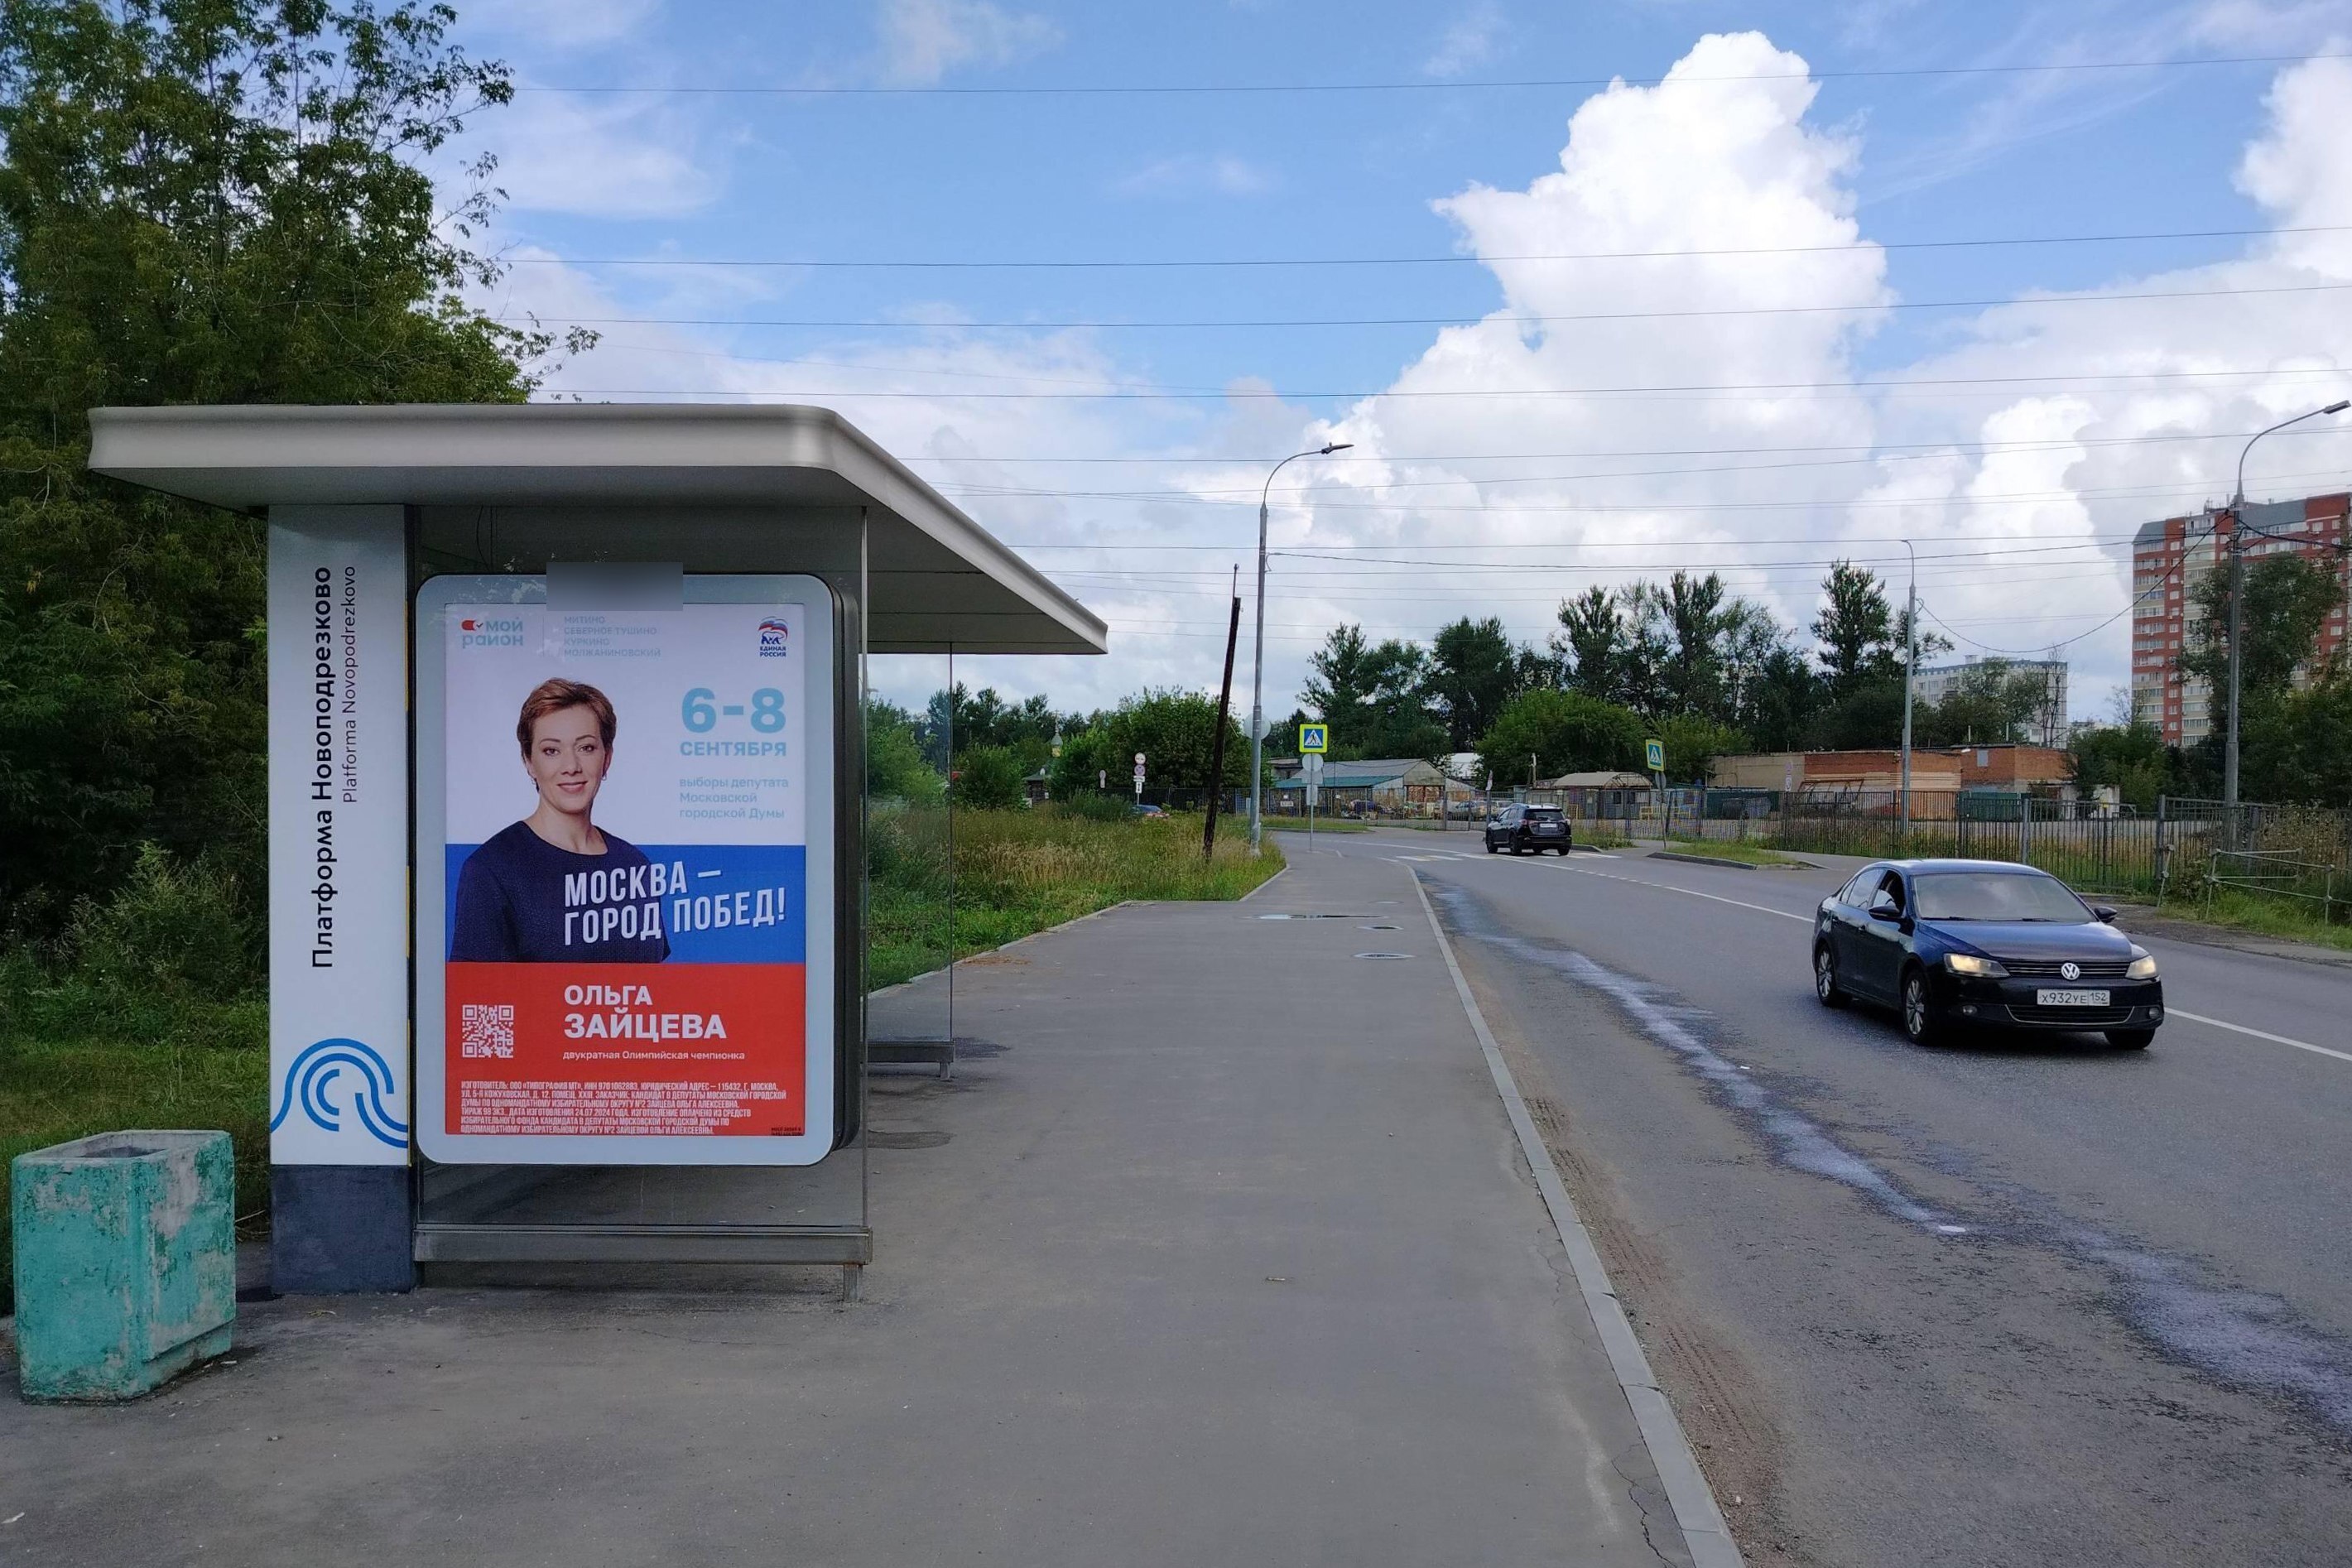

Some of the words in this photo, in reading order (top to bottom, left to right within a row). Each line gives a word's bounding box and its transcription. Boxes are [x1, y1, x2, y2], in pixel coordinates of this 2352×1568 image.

[564, 615, 606, 623] МИТИНО
[564, 627, 613, 635] СЕВЕРНОЕ
[614, 627, 657, 635] ТУШИНО
[340, 566, 358, 713] Novopodrezkovo
[564, 637, 610, 646] КУРКИНО
[564, 647, 661, 657] МОЛЖАНИНОВСКИЙ
[311, 567, 336, 800] Новоподрезково
[680, 741, 786, 757] СЕНТЯБРЯ
[342, 720, 357, 802] Platforma
[679, 777, 729, 789] выборы
[730, 778, 789, 790] депутата
[679, 792, 758, 803] Московской
[679, 808, 745, 820] городской
[748, 808, 785, 820] Думы
[311, 810, 338, 967] Платформа
[565, 861, 687, 907] МОСКВА
[565, 902, 661, 946] ГОРОД
[673, 887, 785, 933] ПОБЕД!
[564, 985, 653, 1006] ОЛЬГА
[564, 1007, 727, 1043] ЗАЙЦЕВА
[562, 1051, 620, 1060] двукратная
[622, 1050, 689, 1061] Олимпийская
[690, 1051, 745, 1061] чемпионка
[689, 1082, 709, 1090] АДРЕС
